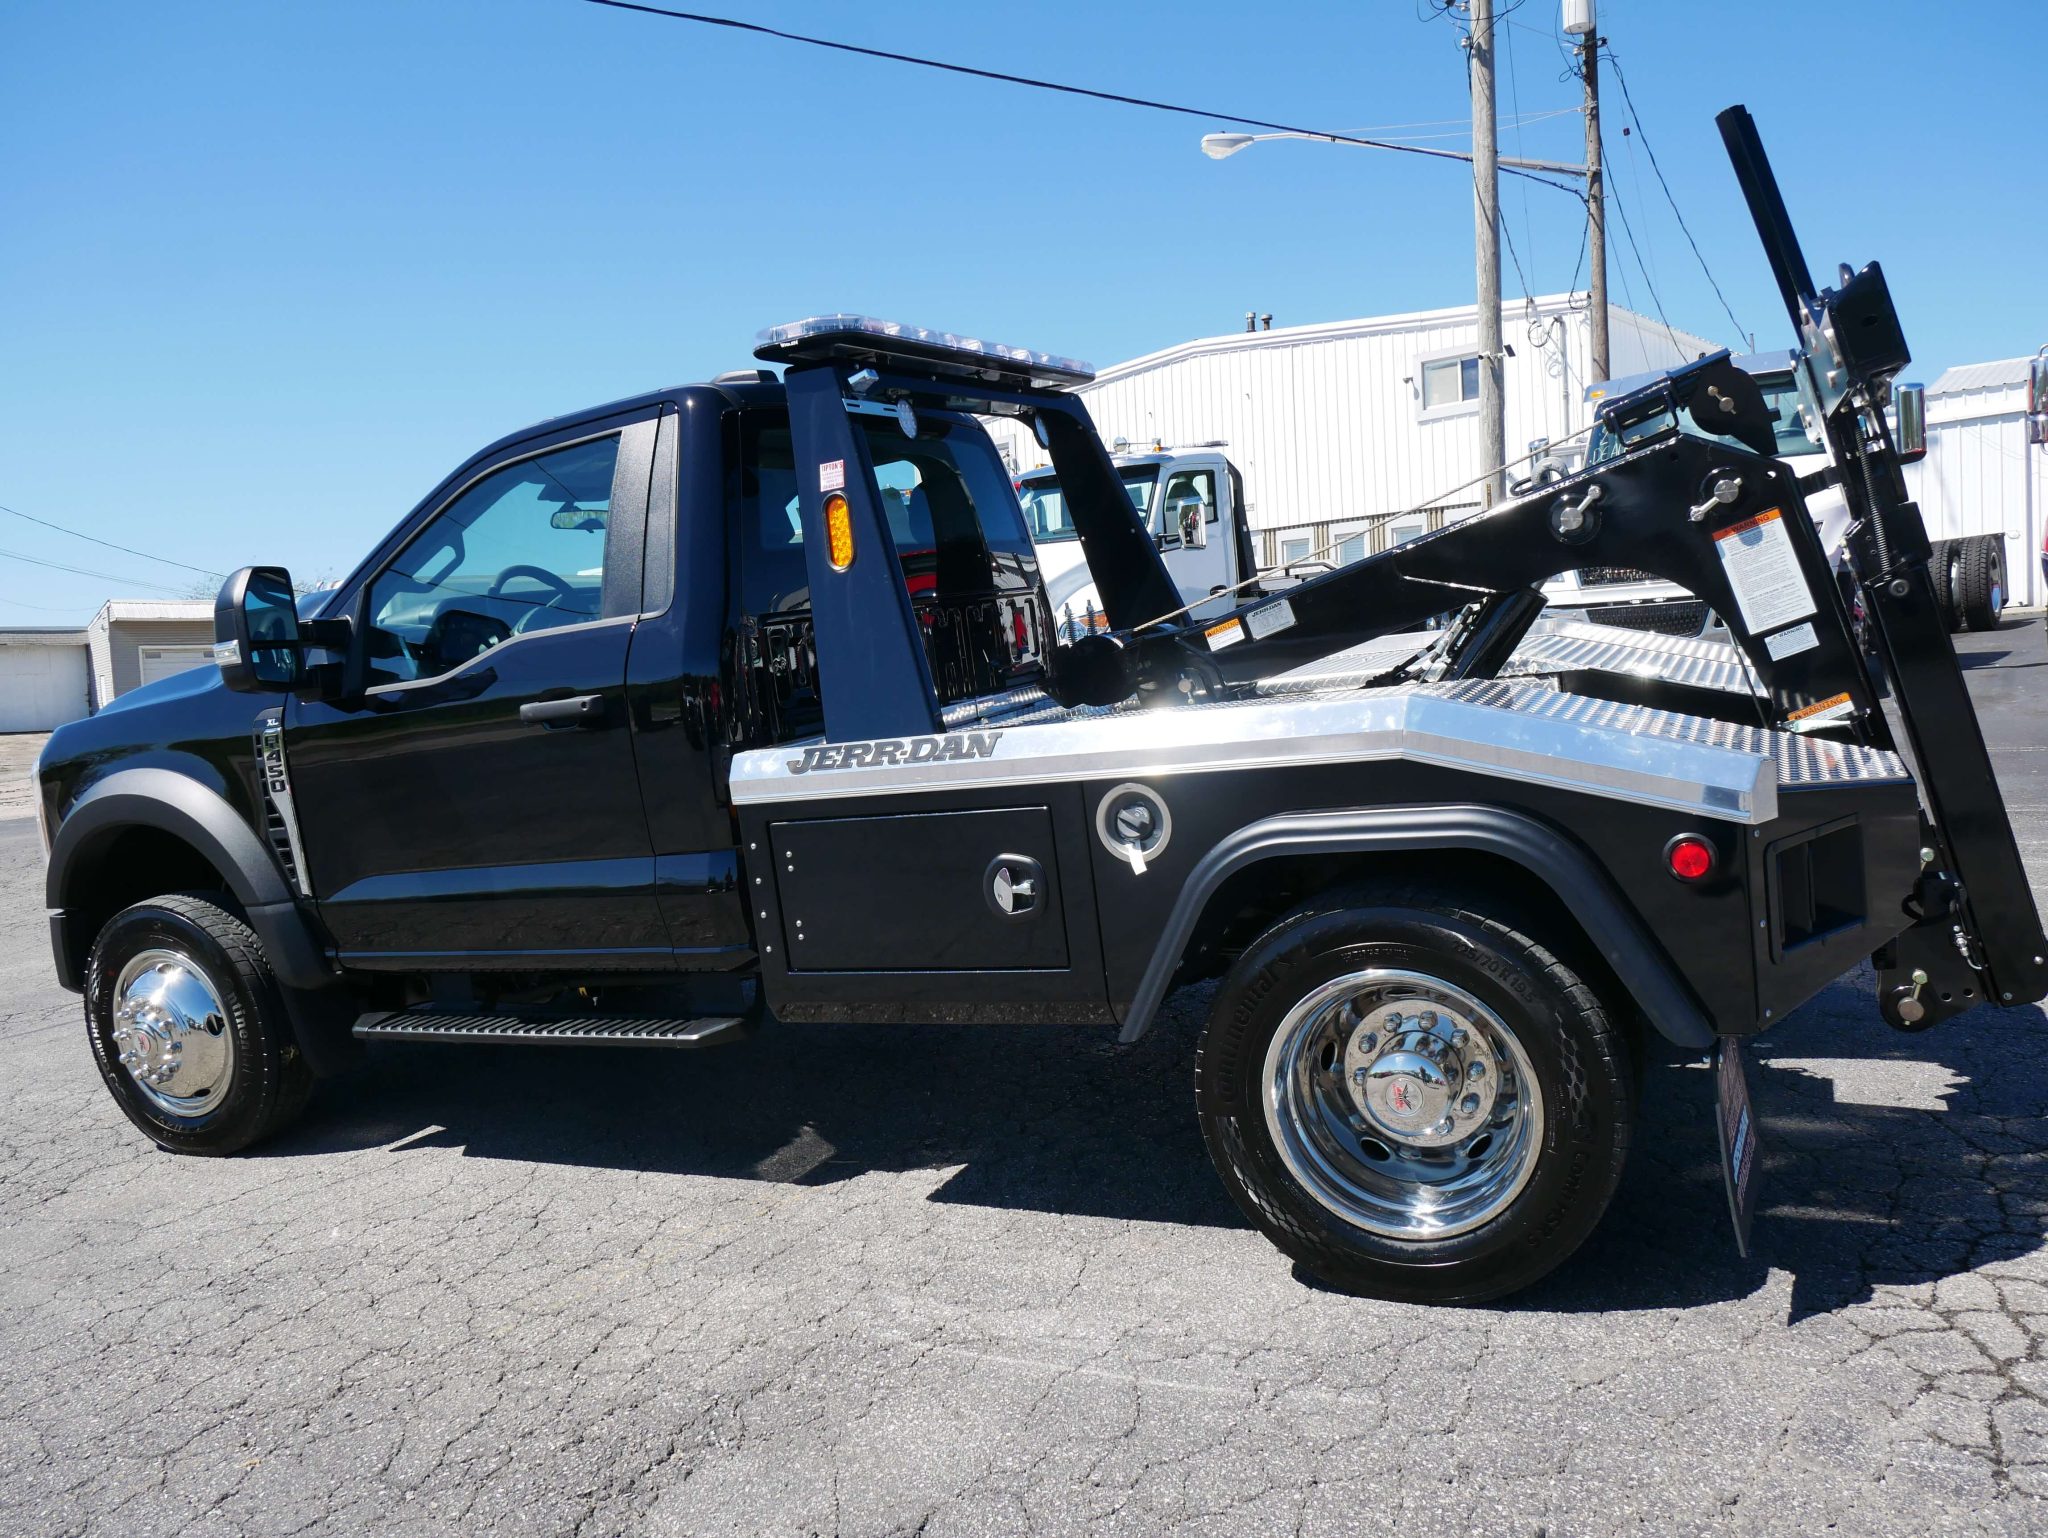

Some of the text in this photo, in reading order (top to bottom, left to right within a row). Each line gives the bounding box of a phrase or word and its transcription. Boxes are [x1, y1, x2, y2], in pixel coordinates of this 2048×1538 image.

[1730, 513, 1770, 533] WARNING
[1210, 618, 1239, 635] WARNING
[1779, 625, 1805, 638] WARNING
[1799, 697, 1843, 717] WARNING
[266, 718, 279, 727] XL
[786, 731, 1003, 776] JERR-DAN
